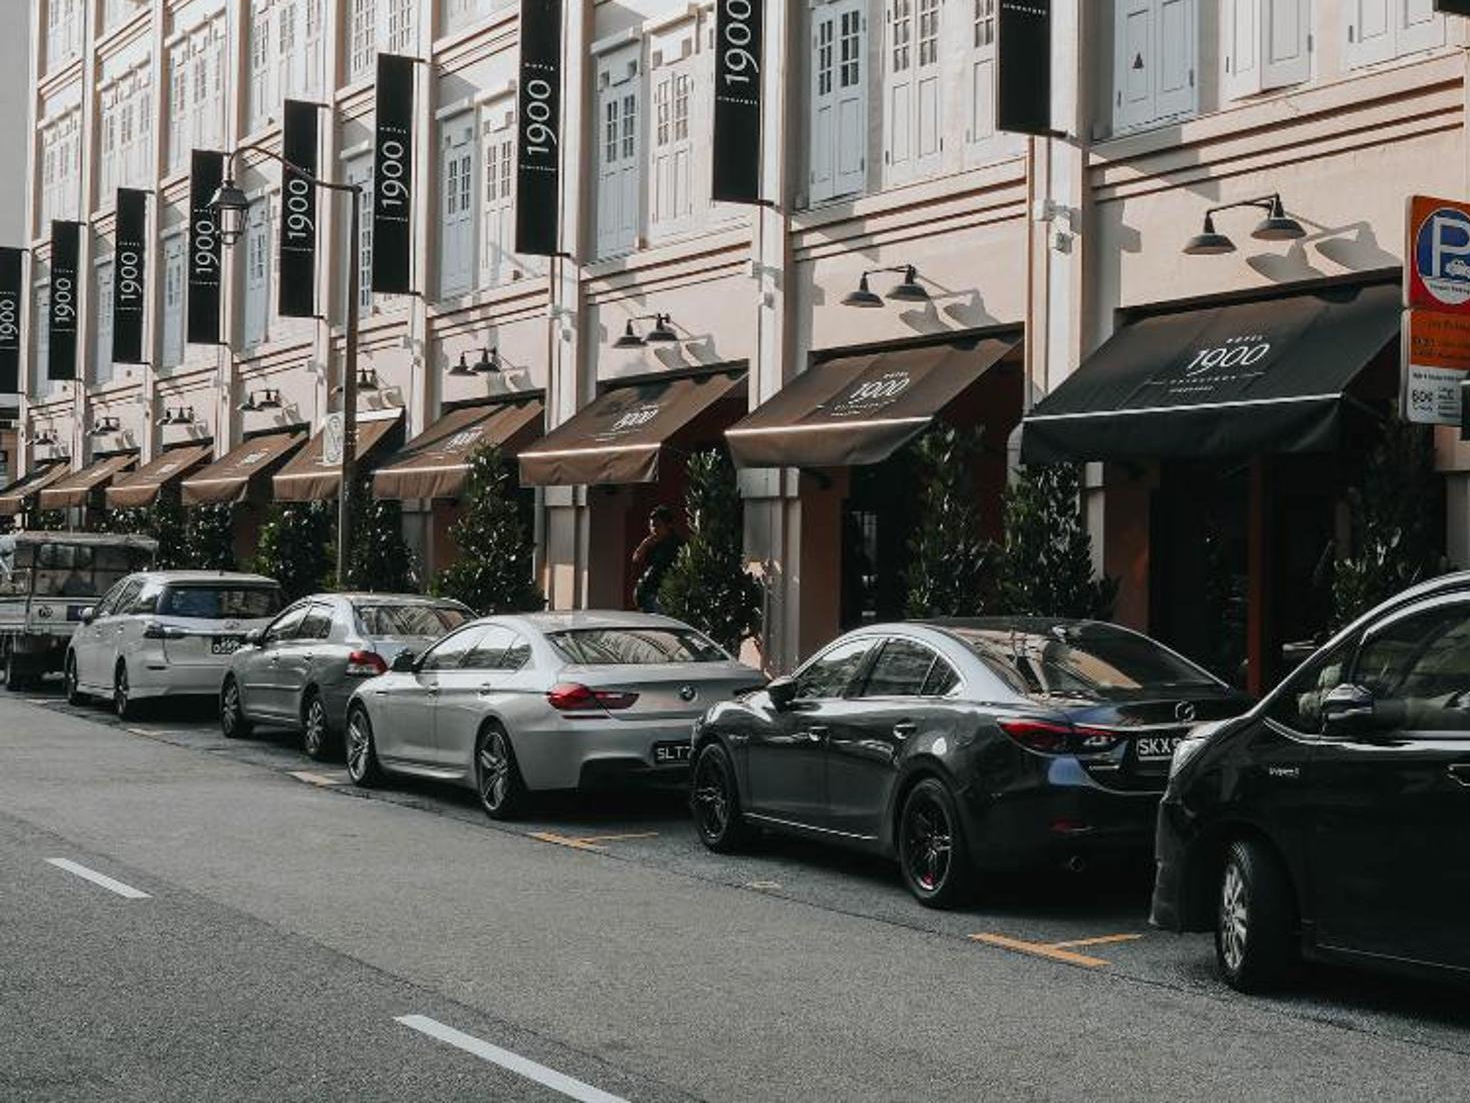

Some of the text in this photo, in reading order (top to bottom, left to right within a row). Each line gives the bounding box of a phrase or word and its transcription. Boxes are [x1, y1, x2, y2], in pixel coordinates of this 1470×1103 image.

[526, 79, 557, 156] 1900
[381, 140, 409, 209] 1900
[287, 179, 314, 239] 1900
[195, 219, 220, 274] 1900
[54, 277, 76, 324] 1900
[120, 251, 142, 301] 1900
[1186, 343, 1270, 377] 1900
